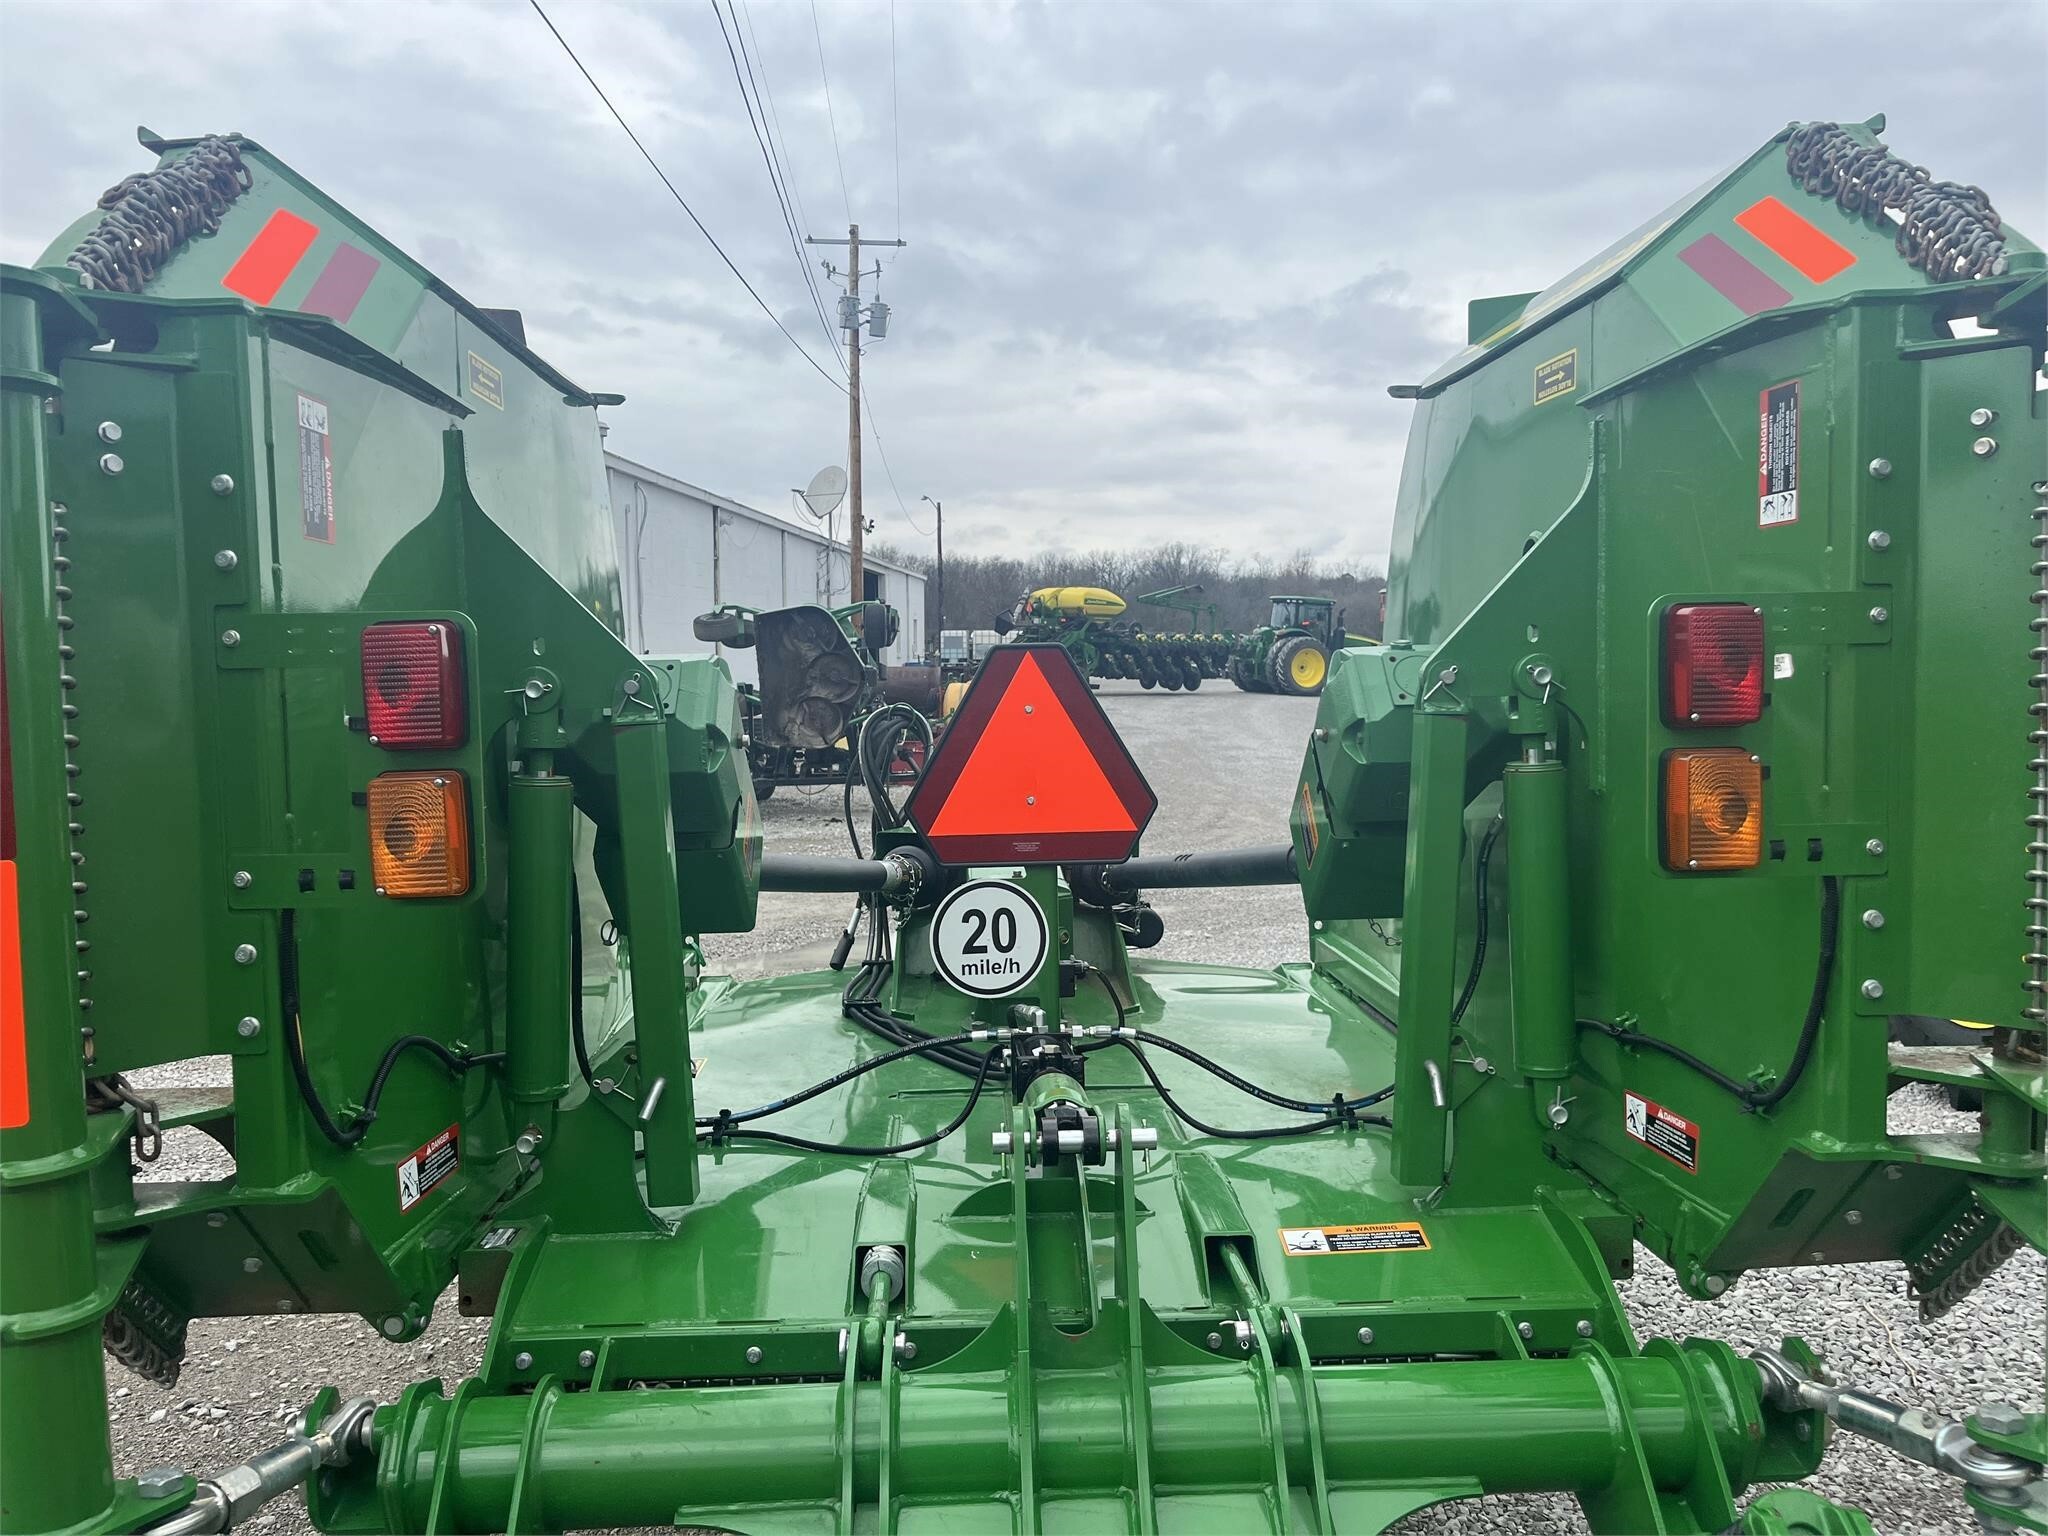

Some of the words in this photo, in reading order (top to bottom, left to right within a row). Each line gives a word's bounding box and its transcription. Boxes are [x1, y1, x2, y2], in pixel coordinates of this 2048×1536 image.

[1760, 413, 1768, 463] DANGER
[326, 471, 334, 521] DANGER
[961, 907, 1017, 955] 20
[961, 958, 1020, 976] mile/h
[1663, 1112, 1687, 1131] DANGER
[431, 1132, 450, 1151] DANGER
[1354, 1224, 1399, 1232] WARNING
